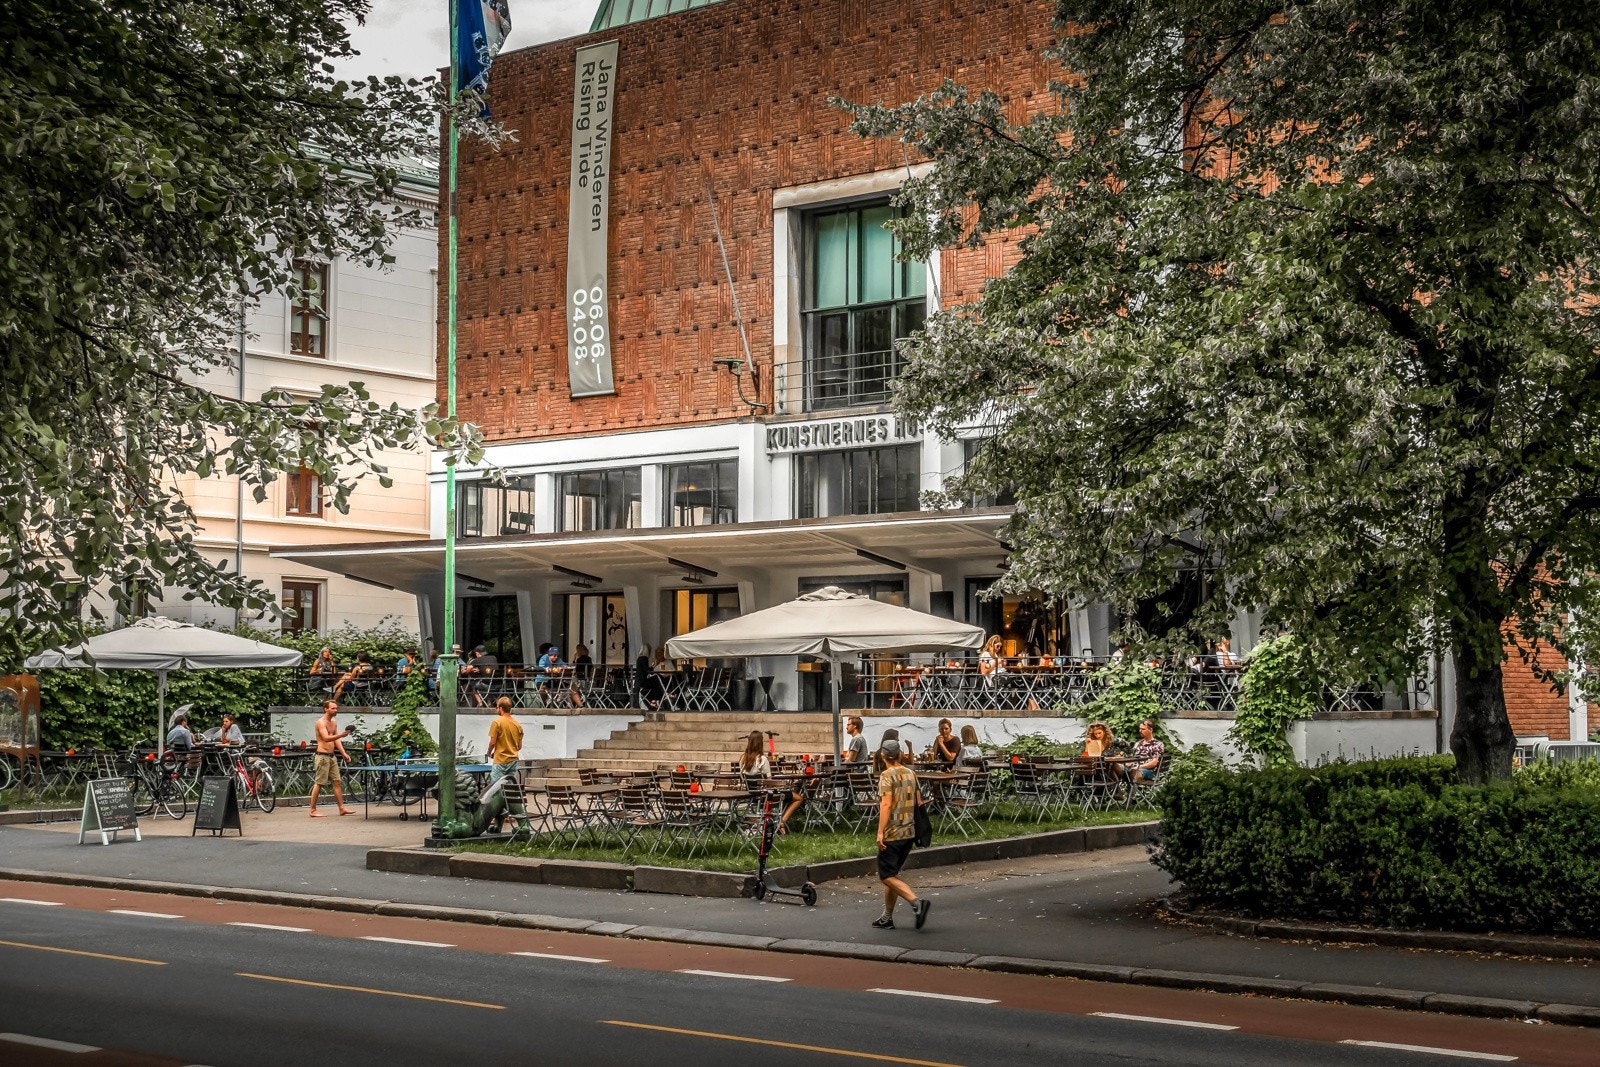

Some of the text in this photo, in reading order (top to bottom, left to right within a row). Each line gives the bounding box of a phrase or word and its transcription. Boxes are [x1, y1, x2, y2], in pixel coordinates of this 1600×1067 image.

[576, 61, 596, 188] Rising Tide
[591, 59, 612, 232] Jana Winderen
[573, 288, 588, 366] 04.08.
[766, 417, 924, 449] KUNSTNERNES HU
